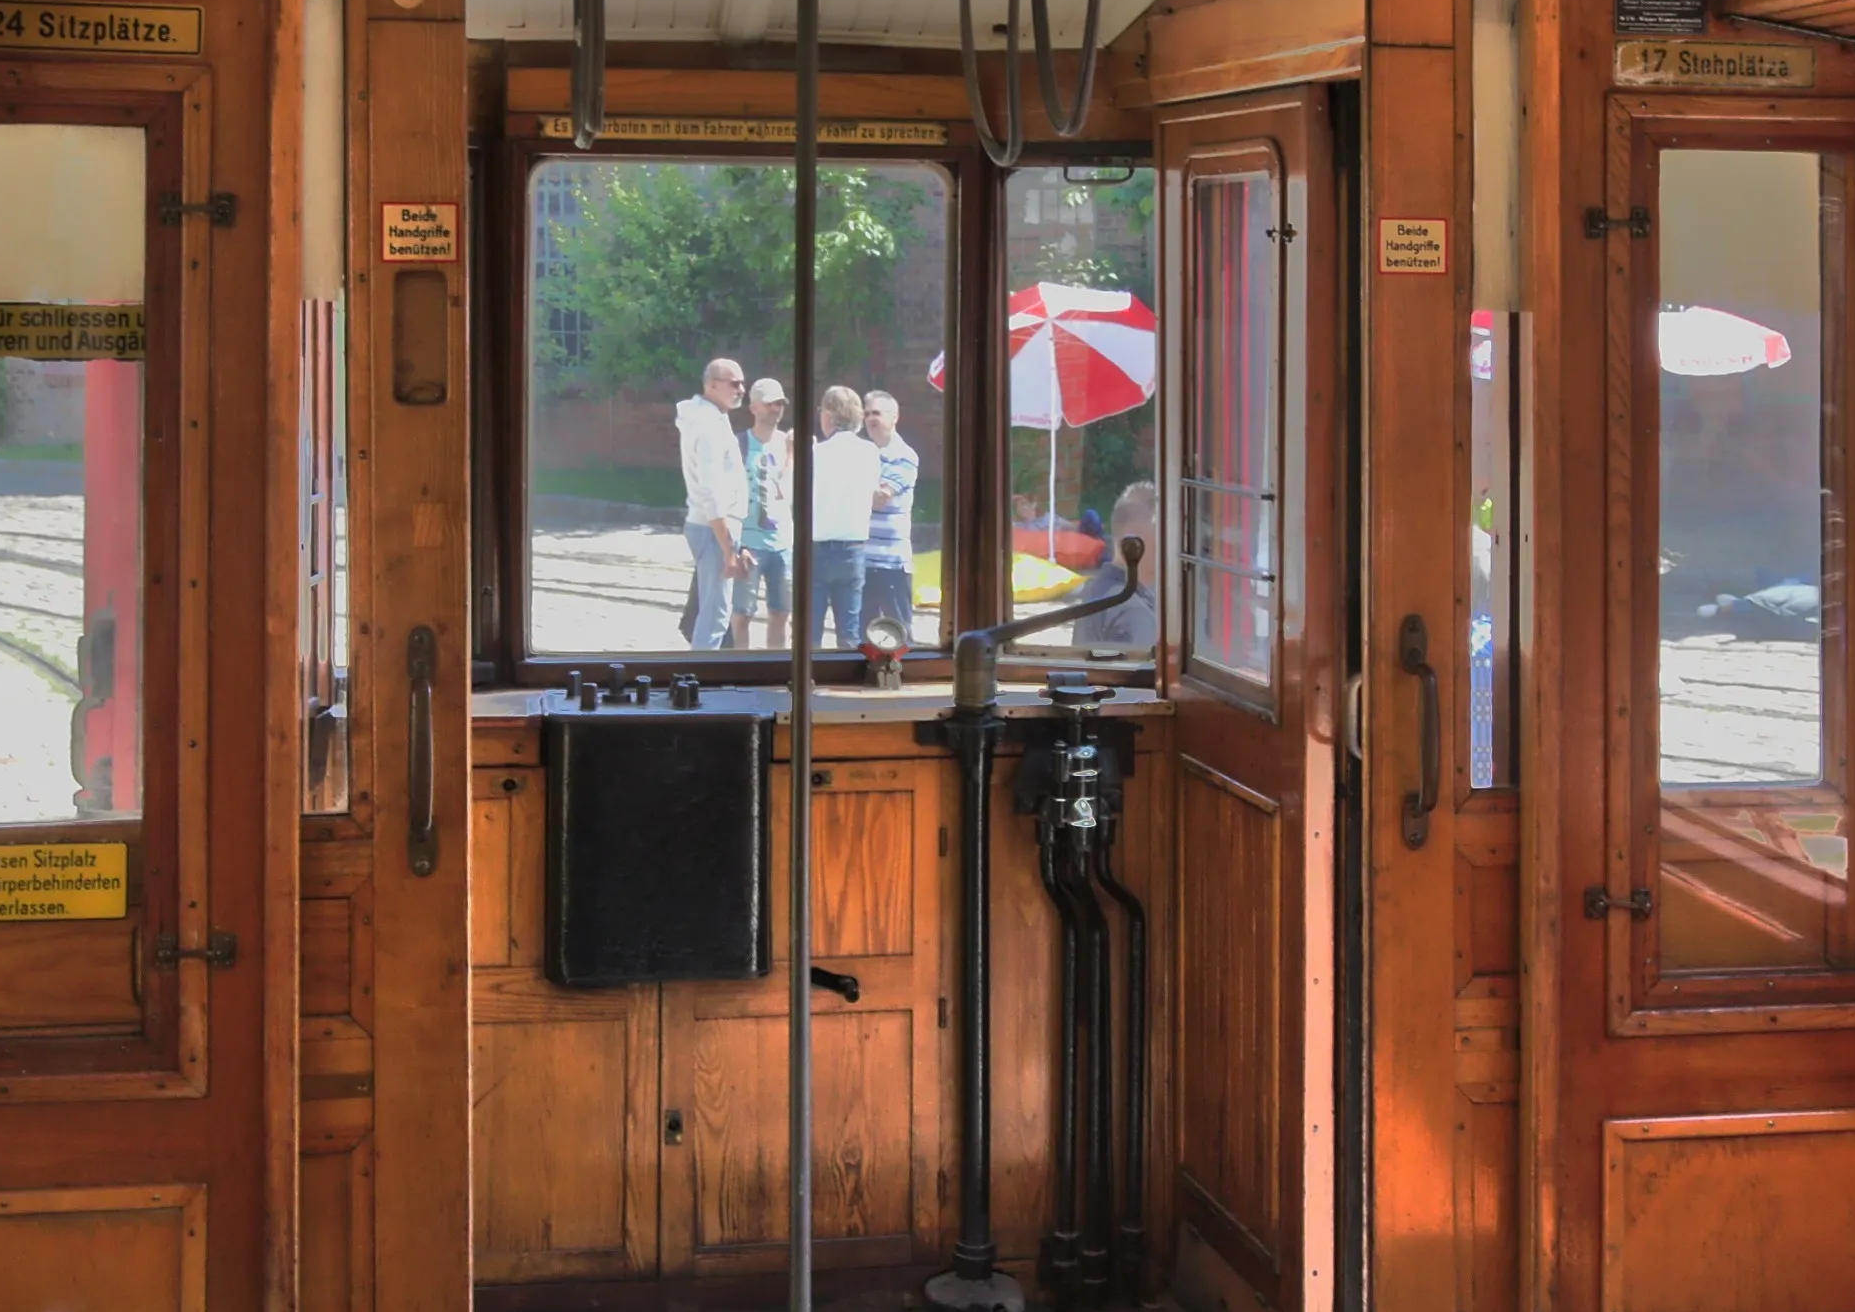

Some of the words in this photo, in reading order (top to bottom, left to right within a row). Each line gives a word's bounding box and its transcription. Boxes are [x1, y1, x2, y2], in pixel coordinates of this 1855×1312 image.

[38, 12, 178, 46] Sitzplätze.
[1641, 49, 1667, 73] 17
[1679, 49, 1790, 80] Stehplätze
[554, 119, 569, 133] Es
[651, 120, 670, 134] mit
[674, 120, 700, 135] dem
[704, 120, 744, 136] Fahrer
[861, 127, 876, 139] zu
[401, 208, 438, 222] Beide
[389, 225, 450, 241] Handgriffe
[1397, 224, 1429, 236] Beide
[389, 242, 451, 255] benützen!
[1386, 240, 1440, 254] Handgriffe
[1386, 256, 1440, 268] benützen!
[19, 308, 130, 328] schliessen
[35, 331, 72, 351] und
[33, 849, 97, 870] Sitzplatz
